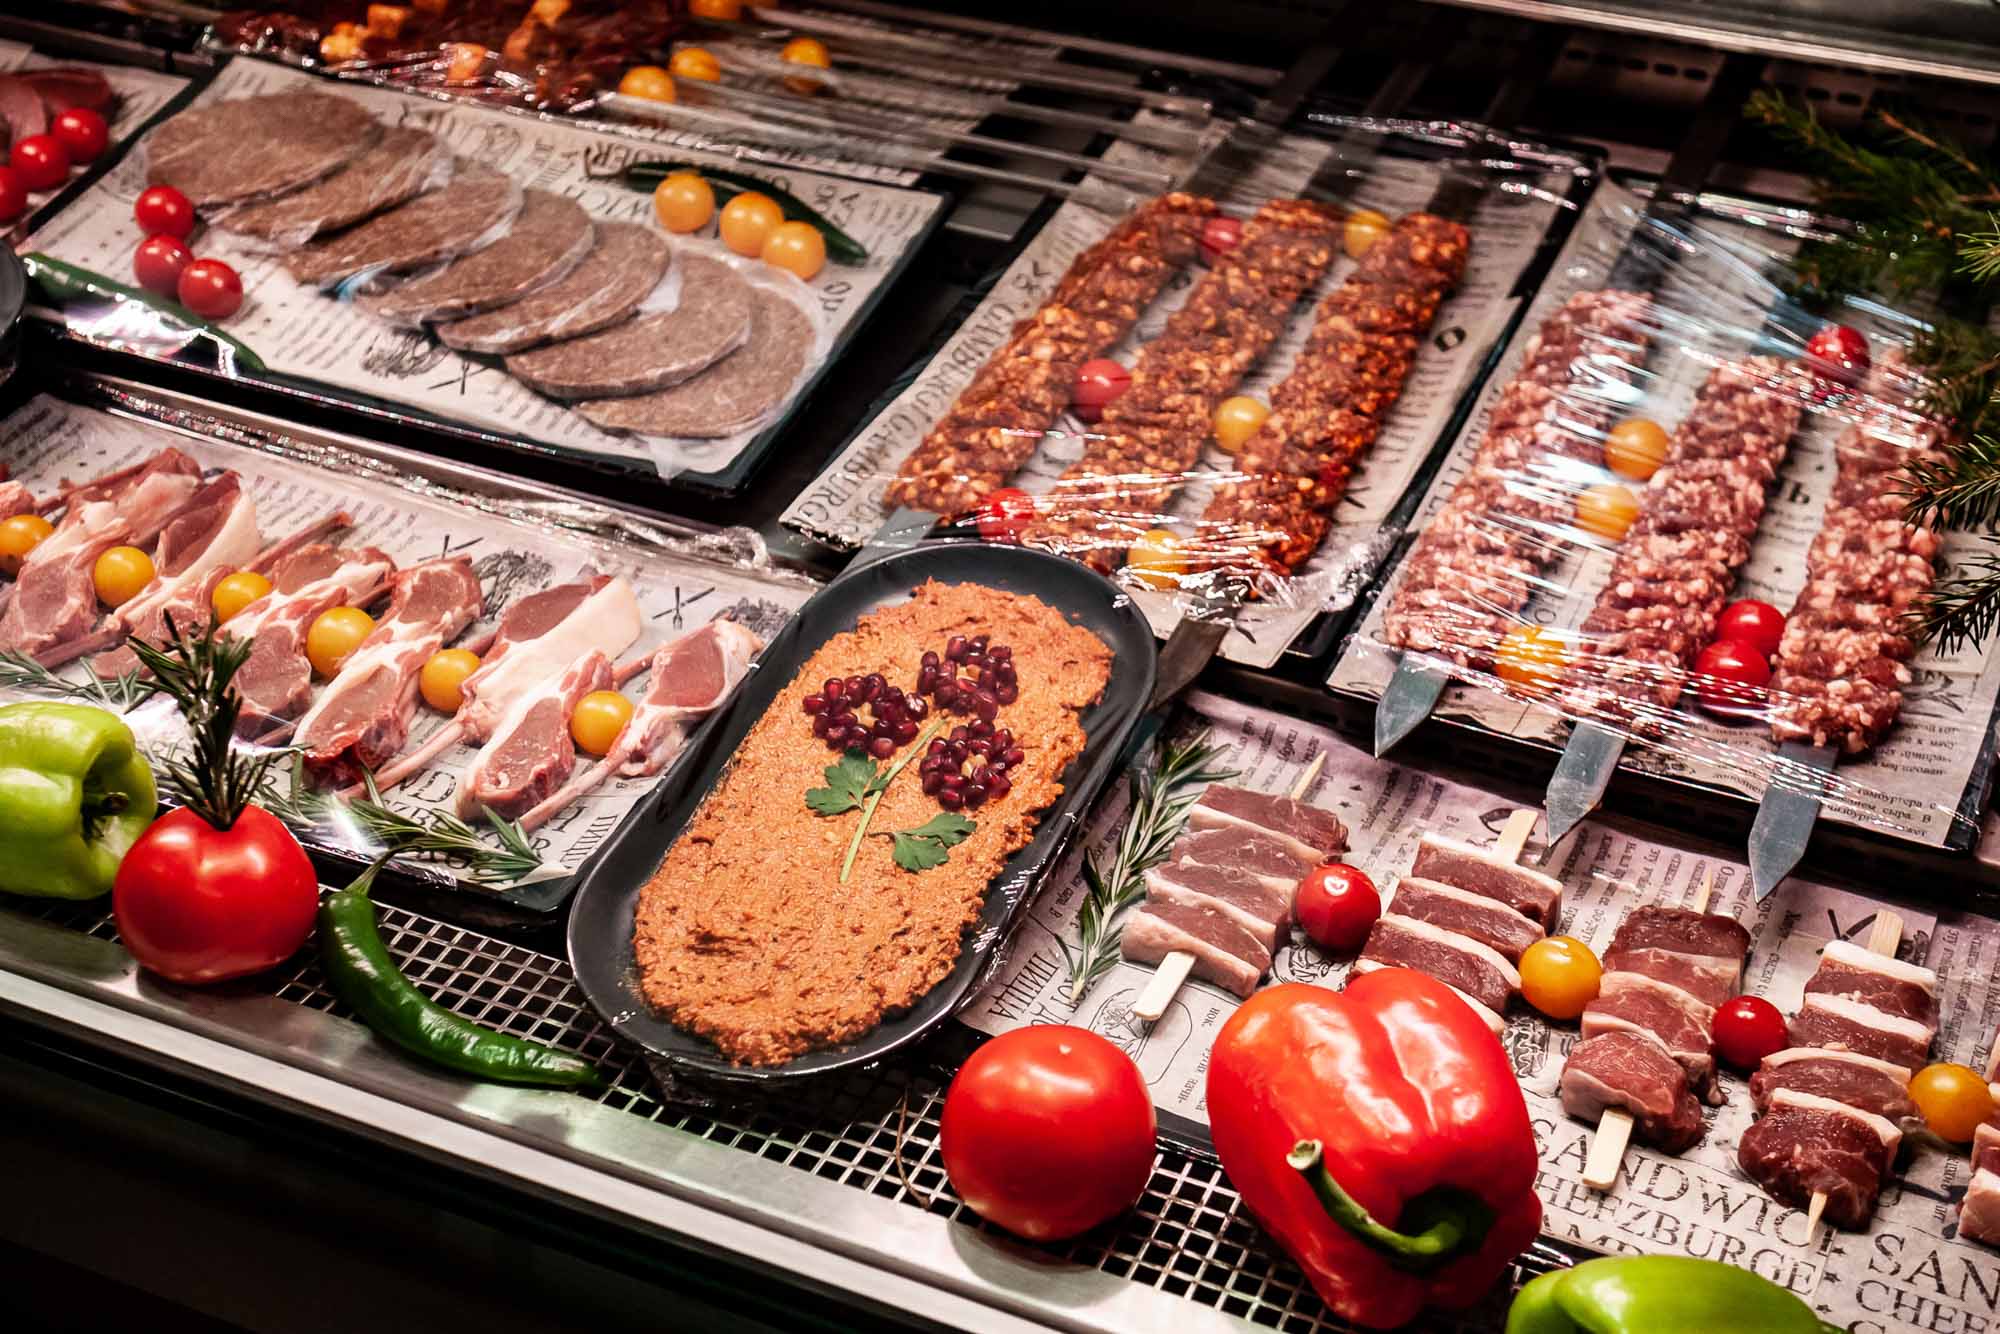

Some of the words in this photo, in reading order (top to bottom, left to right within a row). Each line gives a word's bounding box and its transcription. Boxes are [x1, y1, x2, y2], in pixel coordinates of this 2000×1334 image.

[560, 815, 618, 869] ПИЦЦ
[987, 951, 1060, 1021] ПИЦЦА
[1531, 1117, 1838, 1258] SANDWIC
[1534, 1170, 1818, 1297] HEEZBURGE
[1855, 1279, 2000, 1334] CHEE
